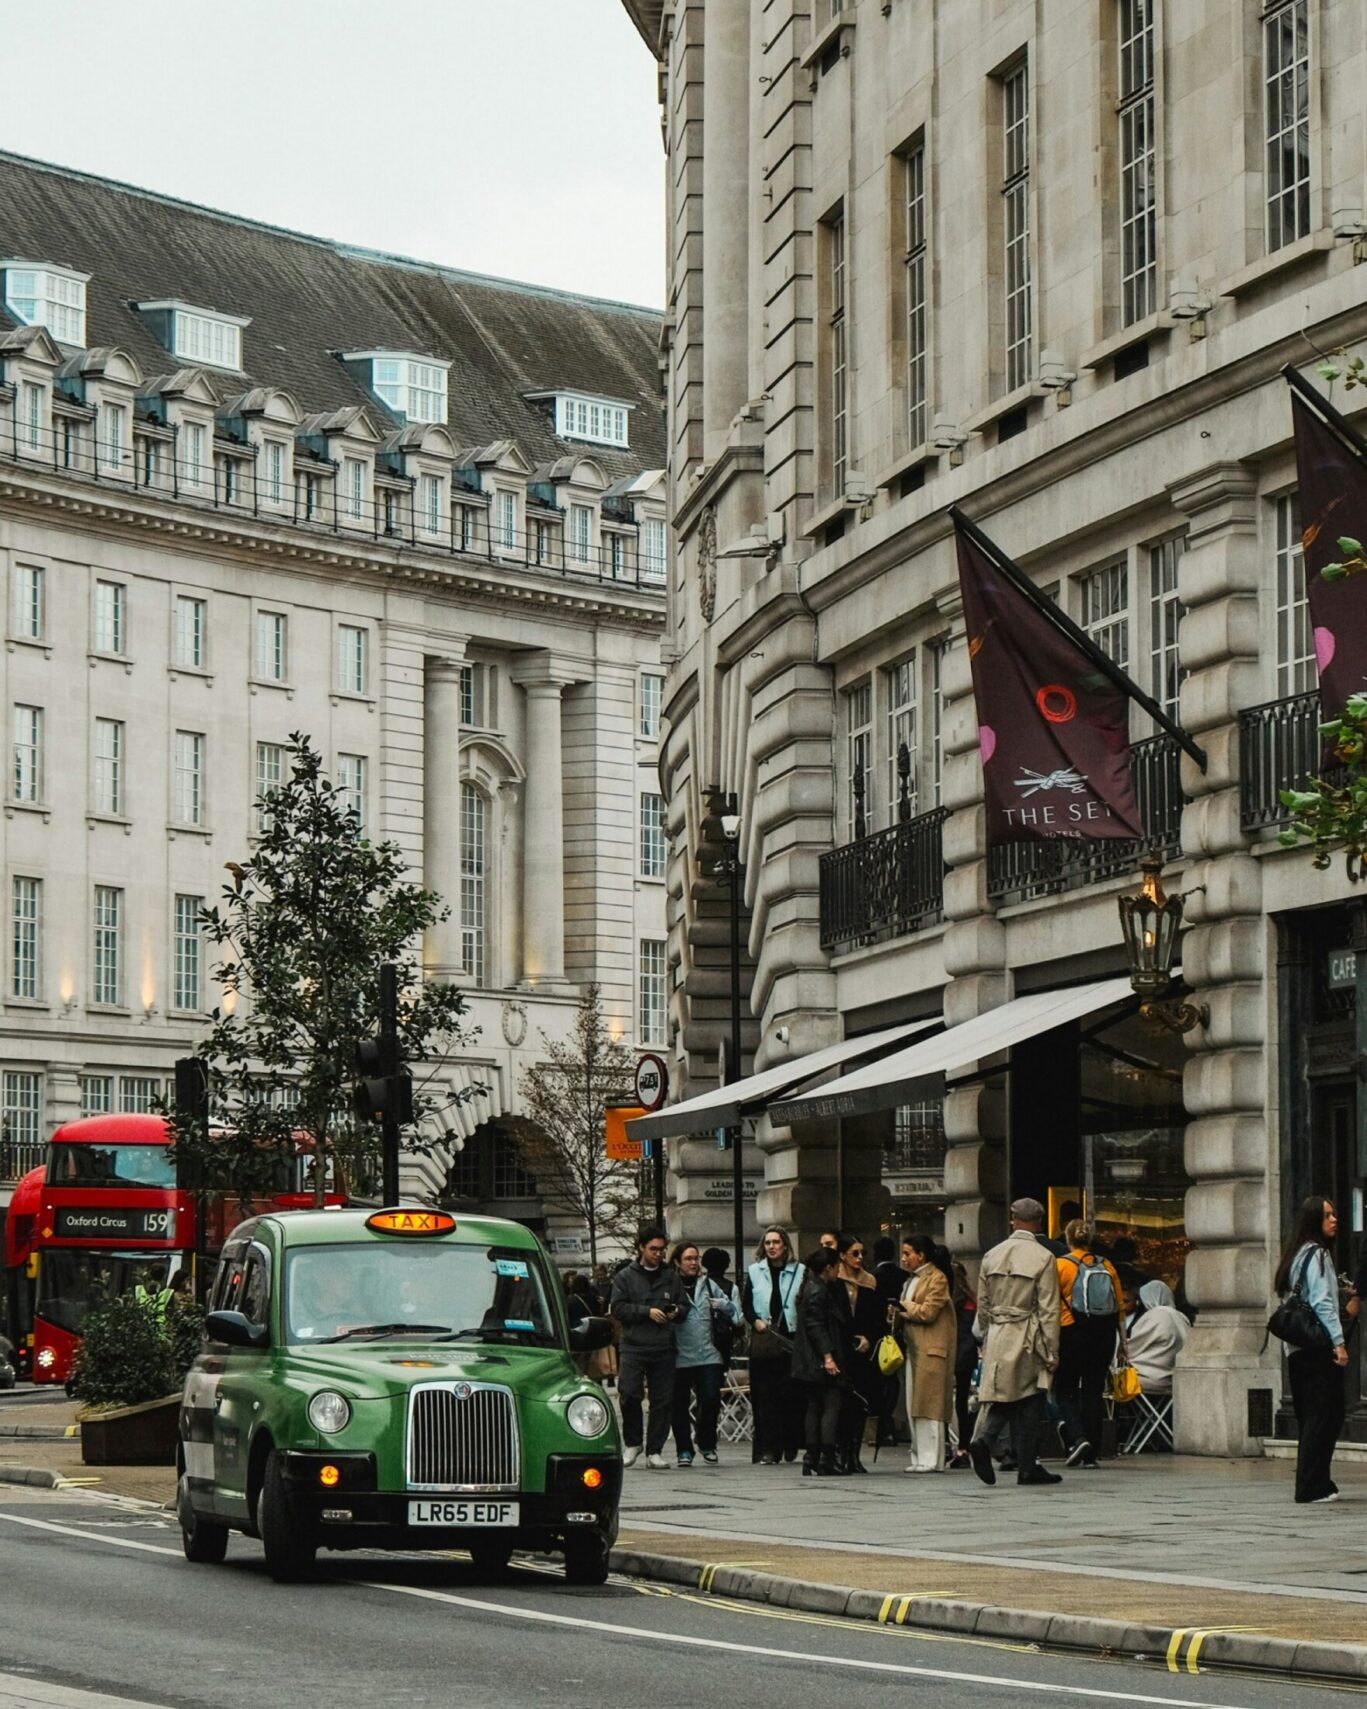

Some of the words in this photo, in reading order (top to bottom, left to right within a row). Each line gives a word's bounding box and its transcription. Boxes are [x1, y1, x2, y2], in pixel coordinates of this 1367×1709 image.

[1002, 806, 1056, 826] THE
[1068, 801, 1111, 821] SET
[745, 1181, 755, 1189] TO
[705, 1190, 733, 1198] GOLDEN
[66, 1215, 98, 1226] Oxford
[99, 1216, 127, 1228] Circus
[143, 1213, 168, 1232] 159
[388, 1215, 439, 1229] TAXI
[416, 1503, 469, 1522] LR65
[473, 1504, 512, 1522] EDF
